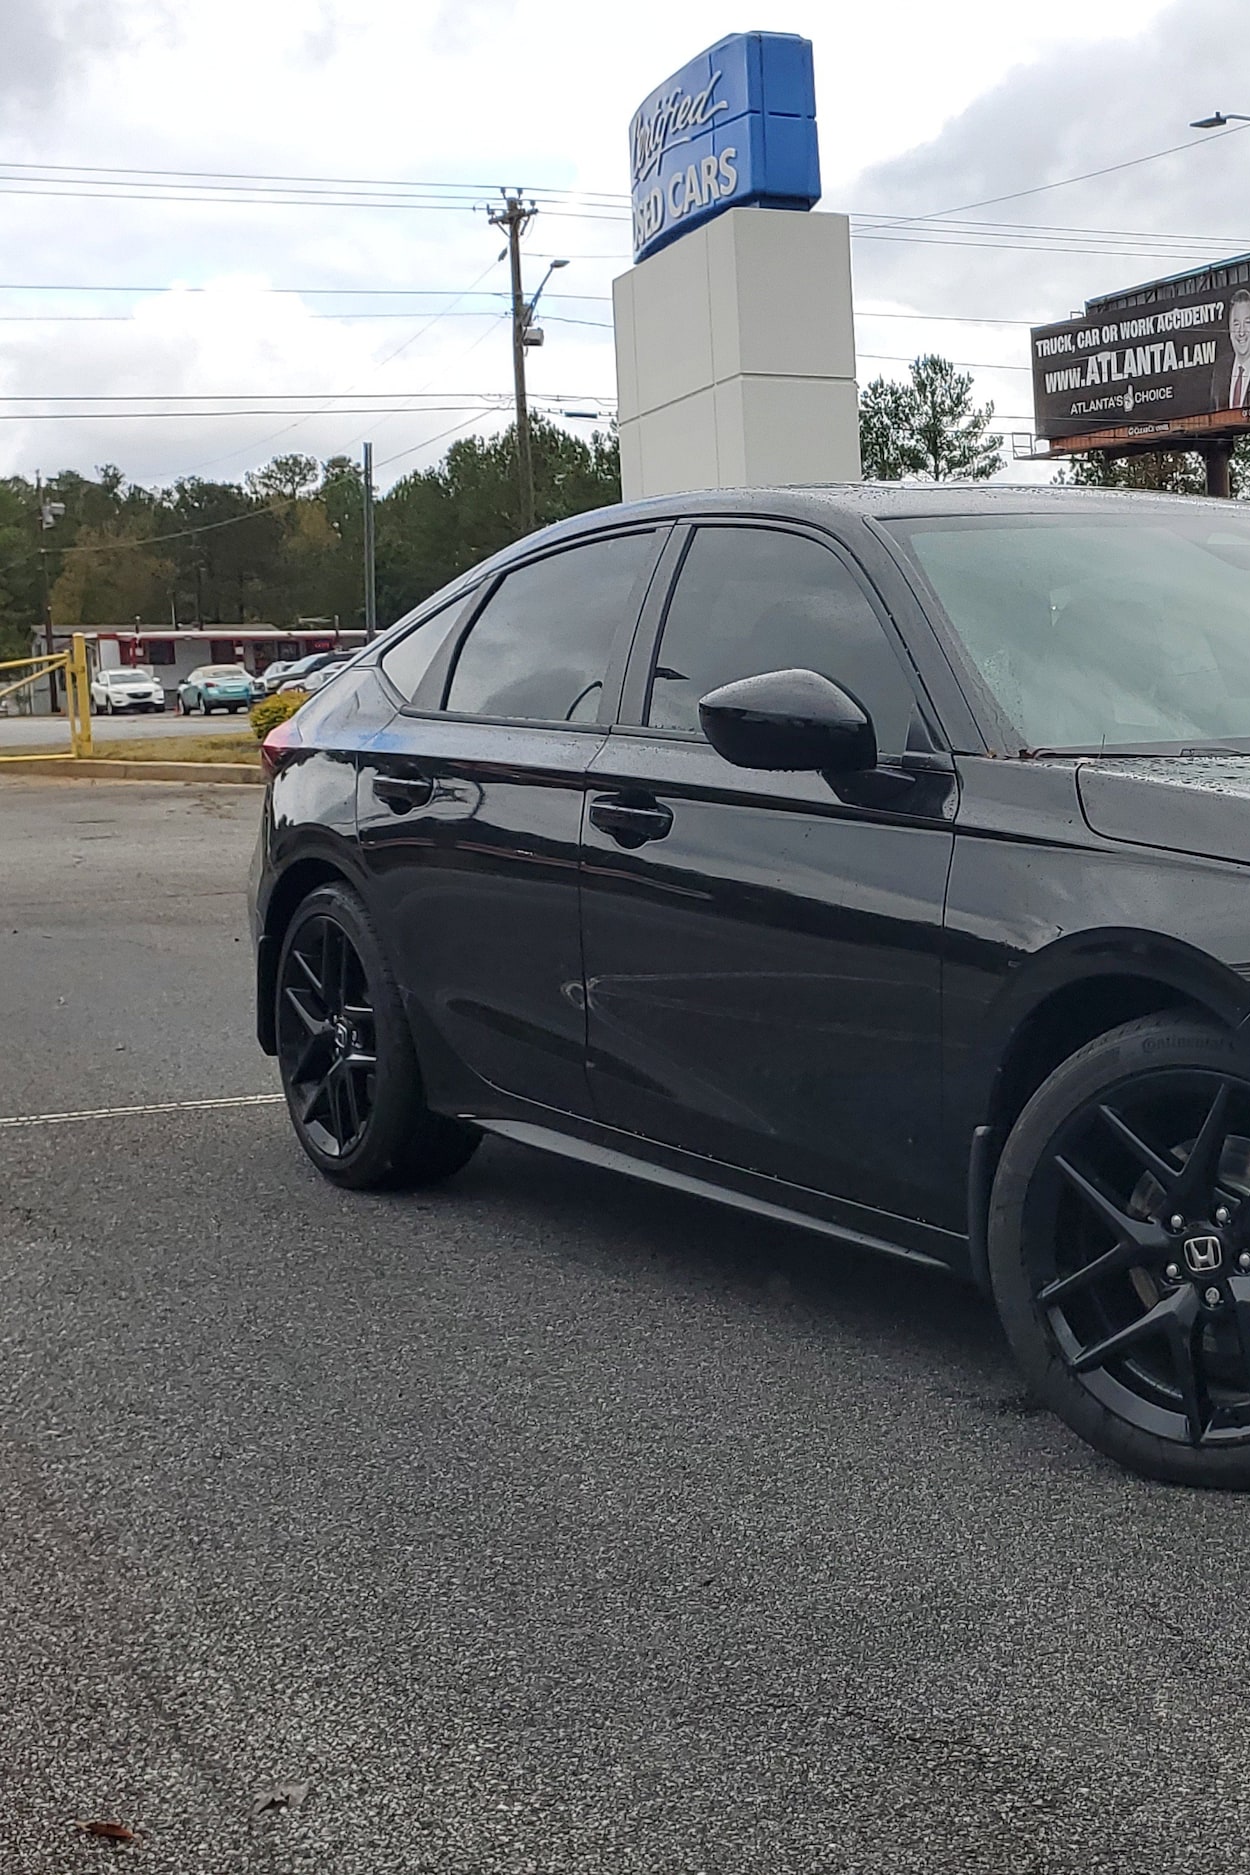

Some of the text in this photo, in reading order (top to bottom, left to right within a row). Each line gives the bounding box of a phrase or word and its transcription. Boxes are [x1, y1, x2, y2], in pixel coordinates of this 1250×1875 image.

[669, 147, 738, 219] CARS
[1036, 302, 1224, 358] TRUCK, CAR OR WORK ACCIDENT?
[1070, 386, 1173, 415] ATLANTA'S CHOICE
